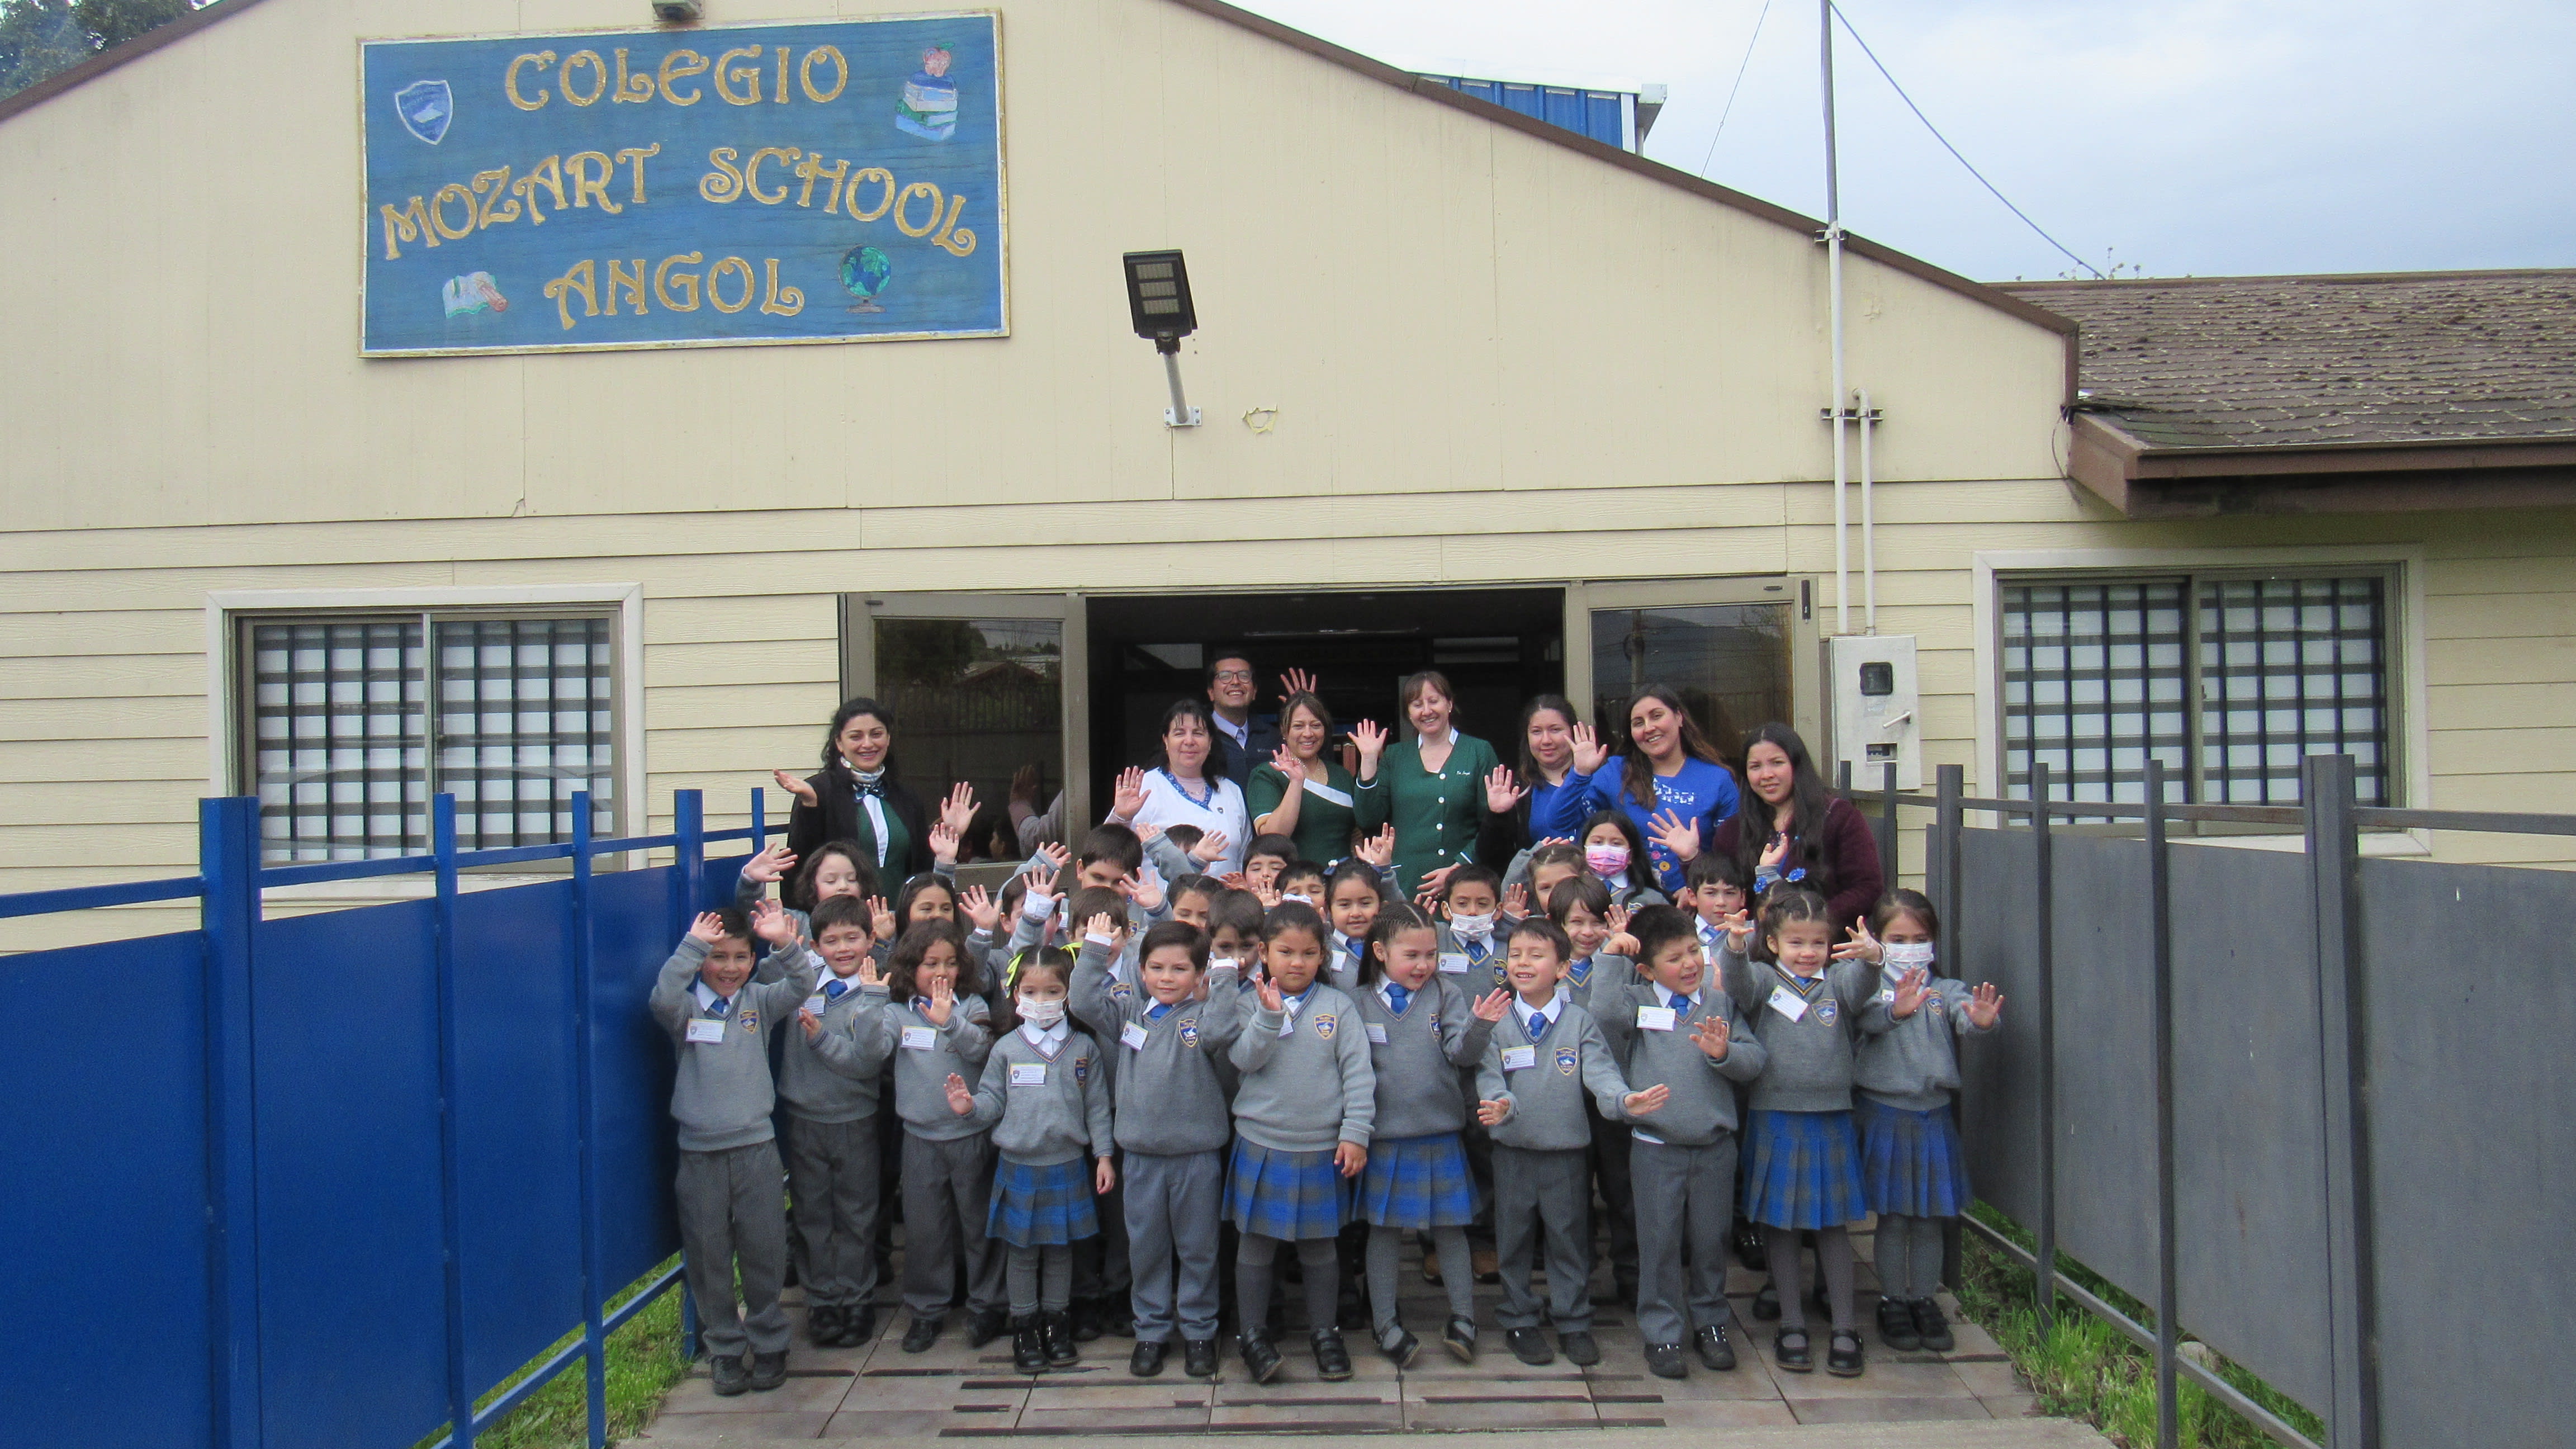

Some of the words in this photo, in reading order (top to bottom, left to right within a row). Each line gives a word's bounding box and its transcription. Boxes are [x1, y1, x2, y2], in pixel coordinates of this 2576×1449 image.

[505, 45, 849, 110] COLEGIO
[381, 143, 660, 259] MOZART
[699, 147, 977, 257] SCHOOL
[544, 251, 805, 329] ANGOL
